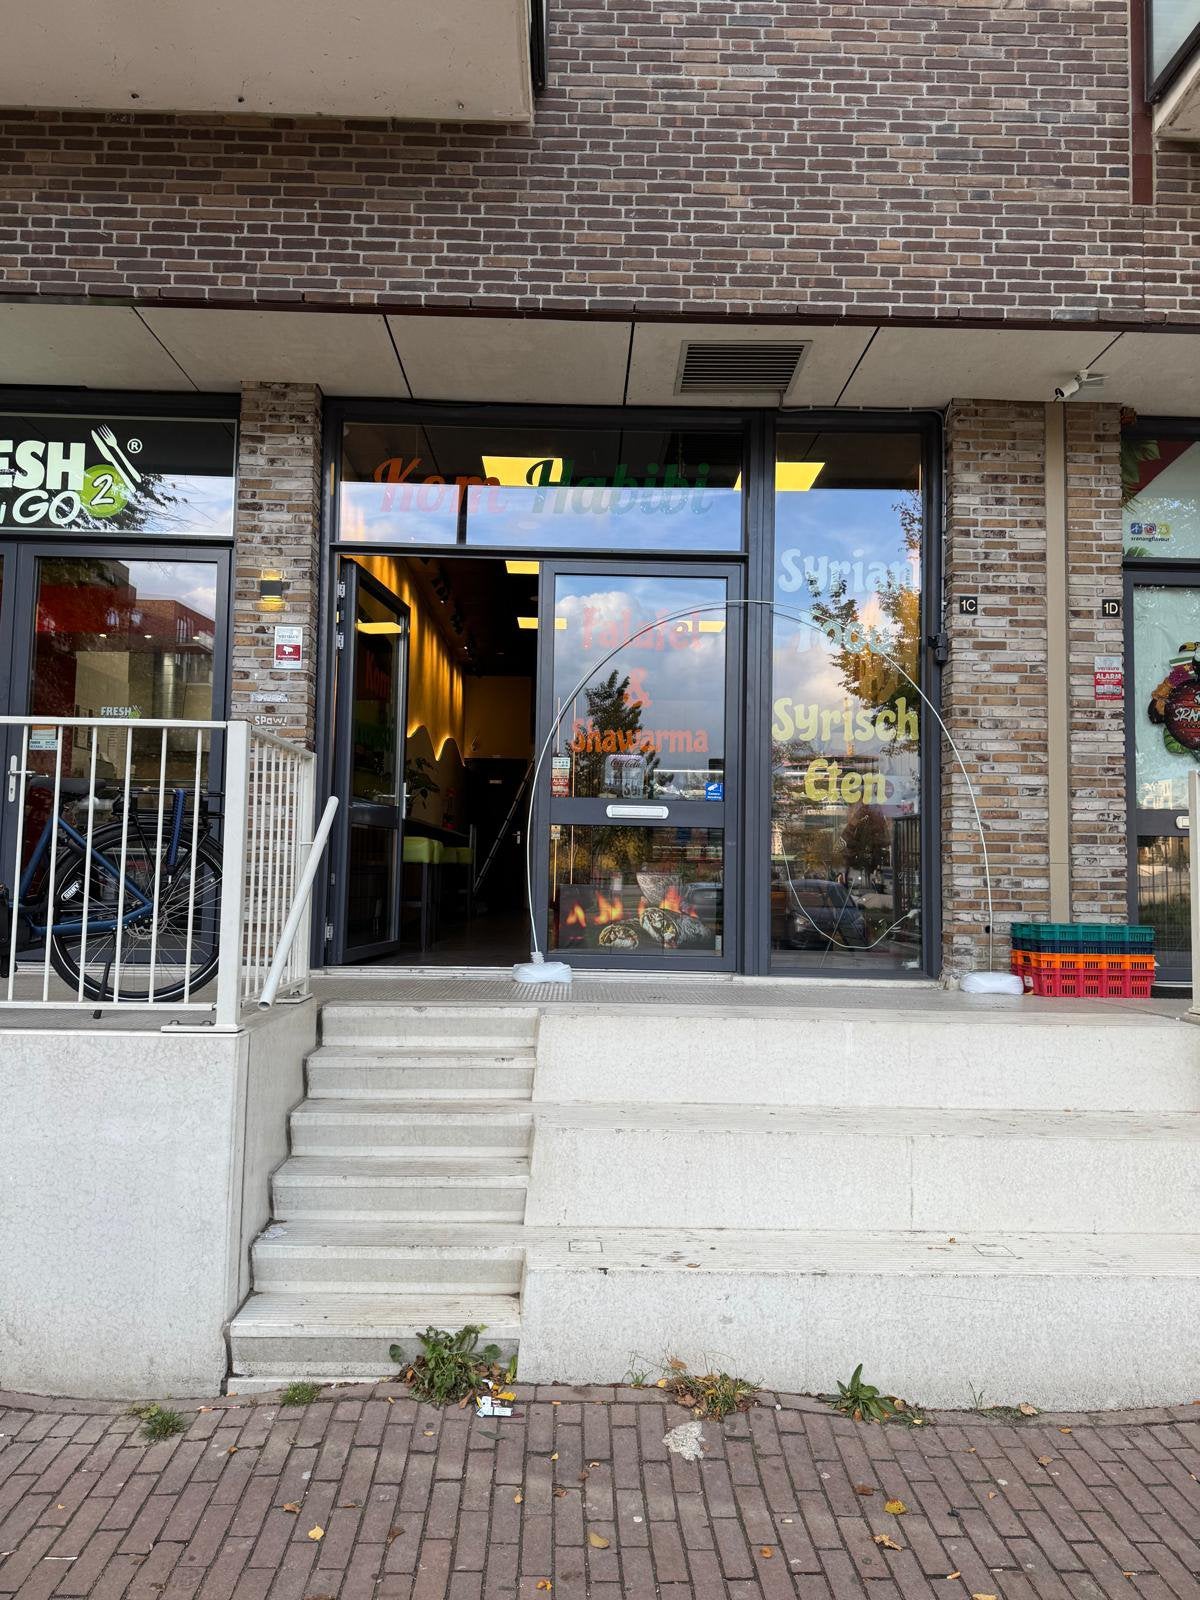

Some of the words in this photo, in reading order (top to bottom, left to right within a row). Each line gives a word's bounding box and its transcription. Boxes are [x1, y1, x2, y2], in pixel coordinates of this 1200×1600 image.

[373, 457, 507, 513] Kom
[525, 459, 714, 515] Habibi
[12, 489, 81, 525] GO
[778, 548, 921, 594] Syrian
[961, 599, 976, 611] 1C
[1104, 602, 1119, 614] 1D
[623, 667, 653, 708] &
[100, 706, 132, 716] FRESH
[771, 696, 920, 742] Syrisch
[570, 718, 709, 753] Shawarma
[804, 758, 888, 805] Eten
